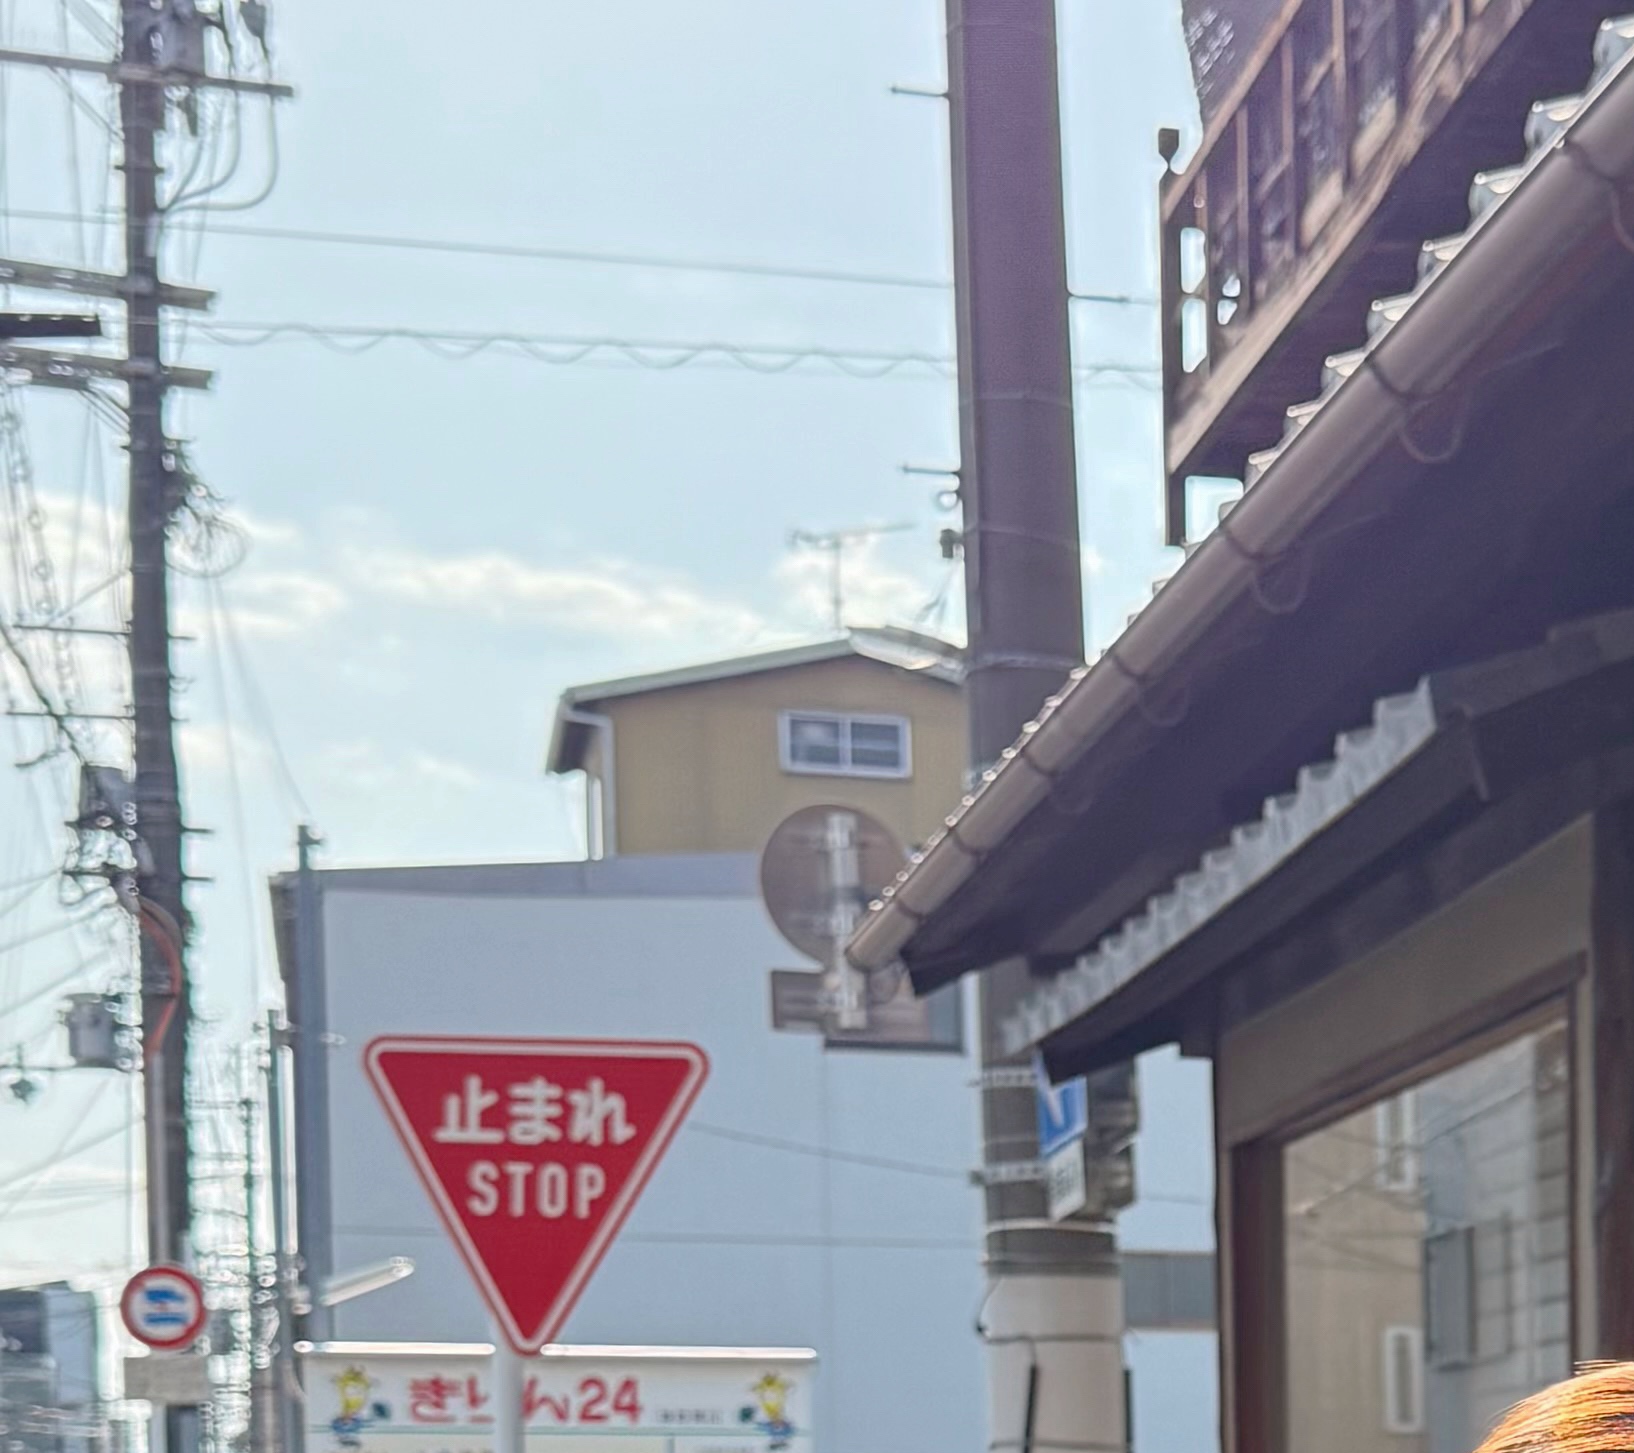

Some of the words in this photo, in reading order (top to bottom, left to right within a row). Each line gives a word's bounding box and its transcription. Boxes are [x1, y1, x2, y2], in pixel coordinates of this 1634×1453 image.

[432, 1074, 637, 1146] 止まれ
[466, 1161, 607, 1219] STOP
